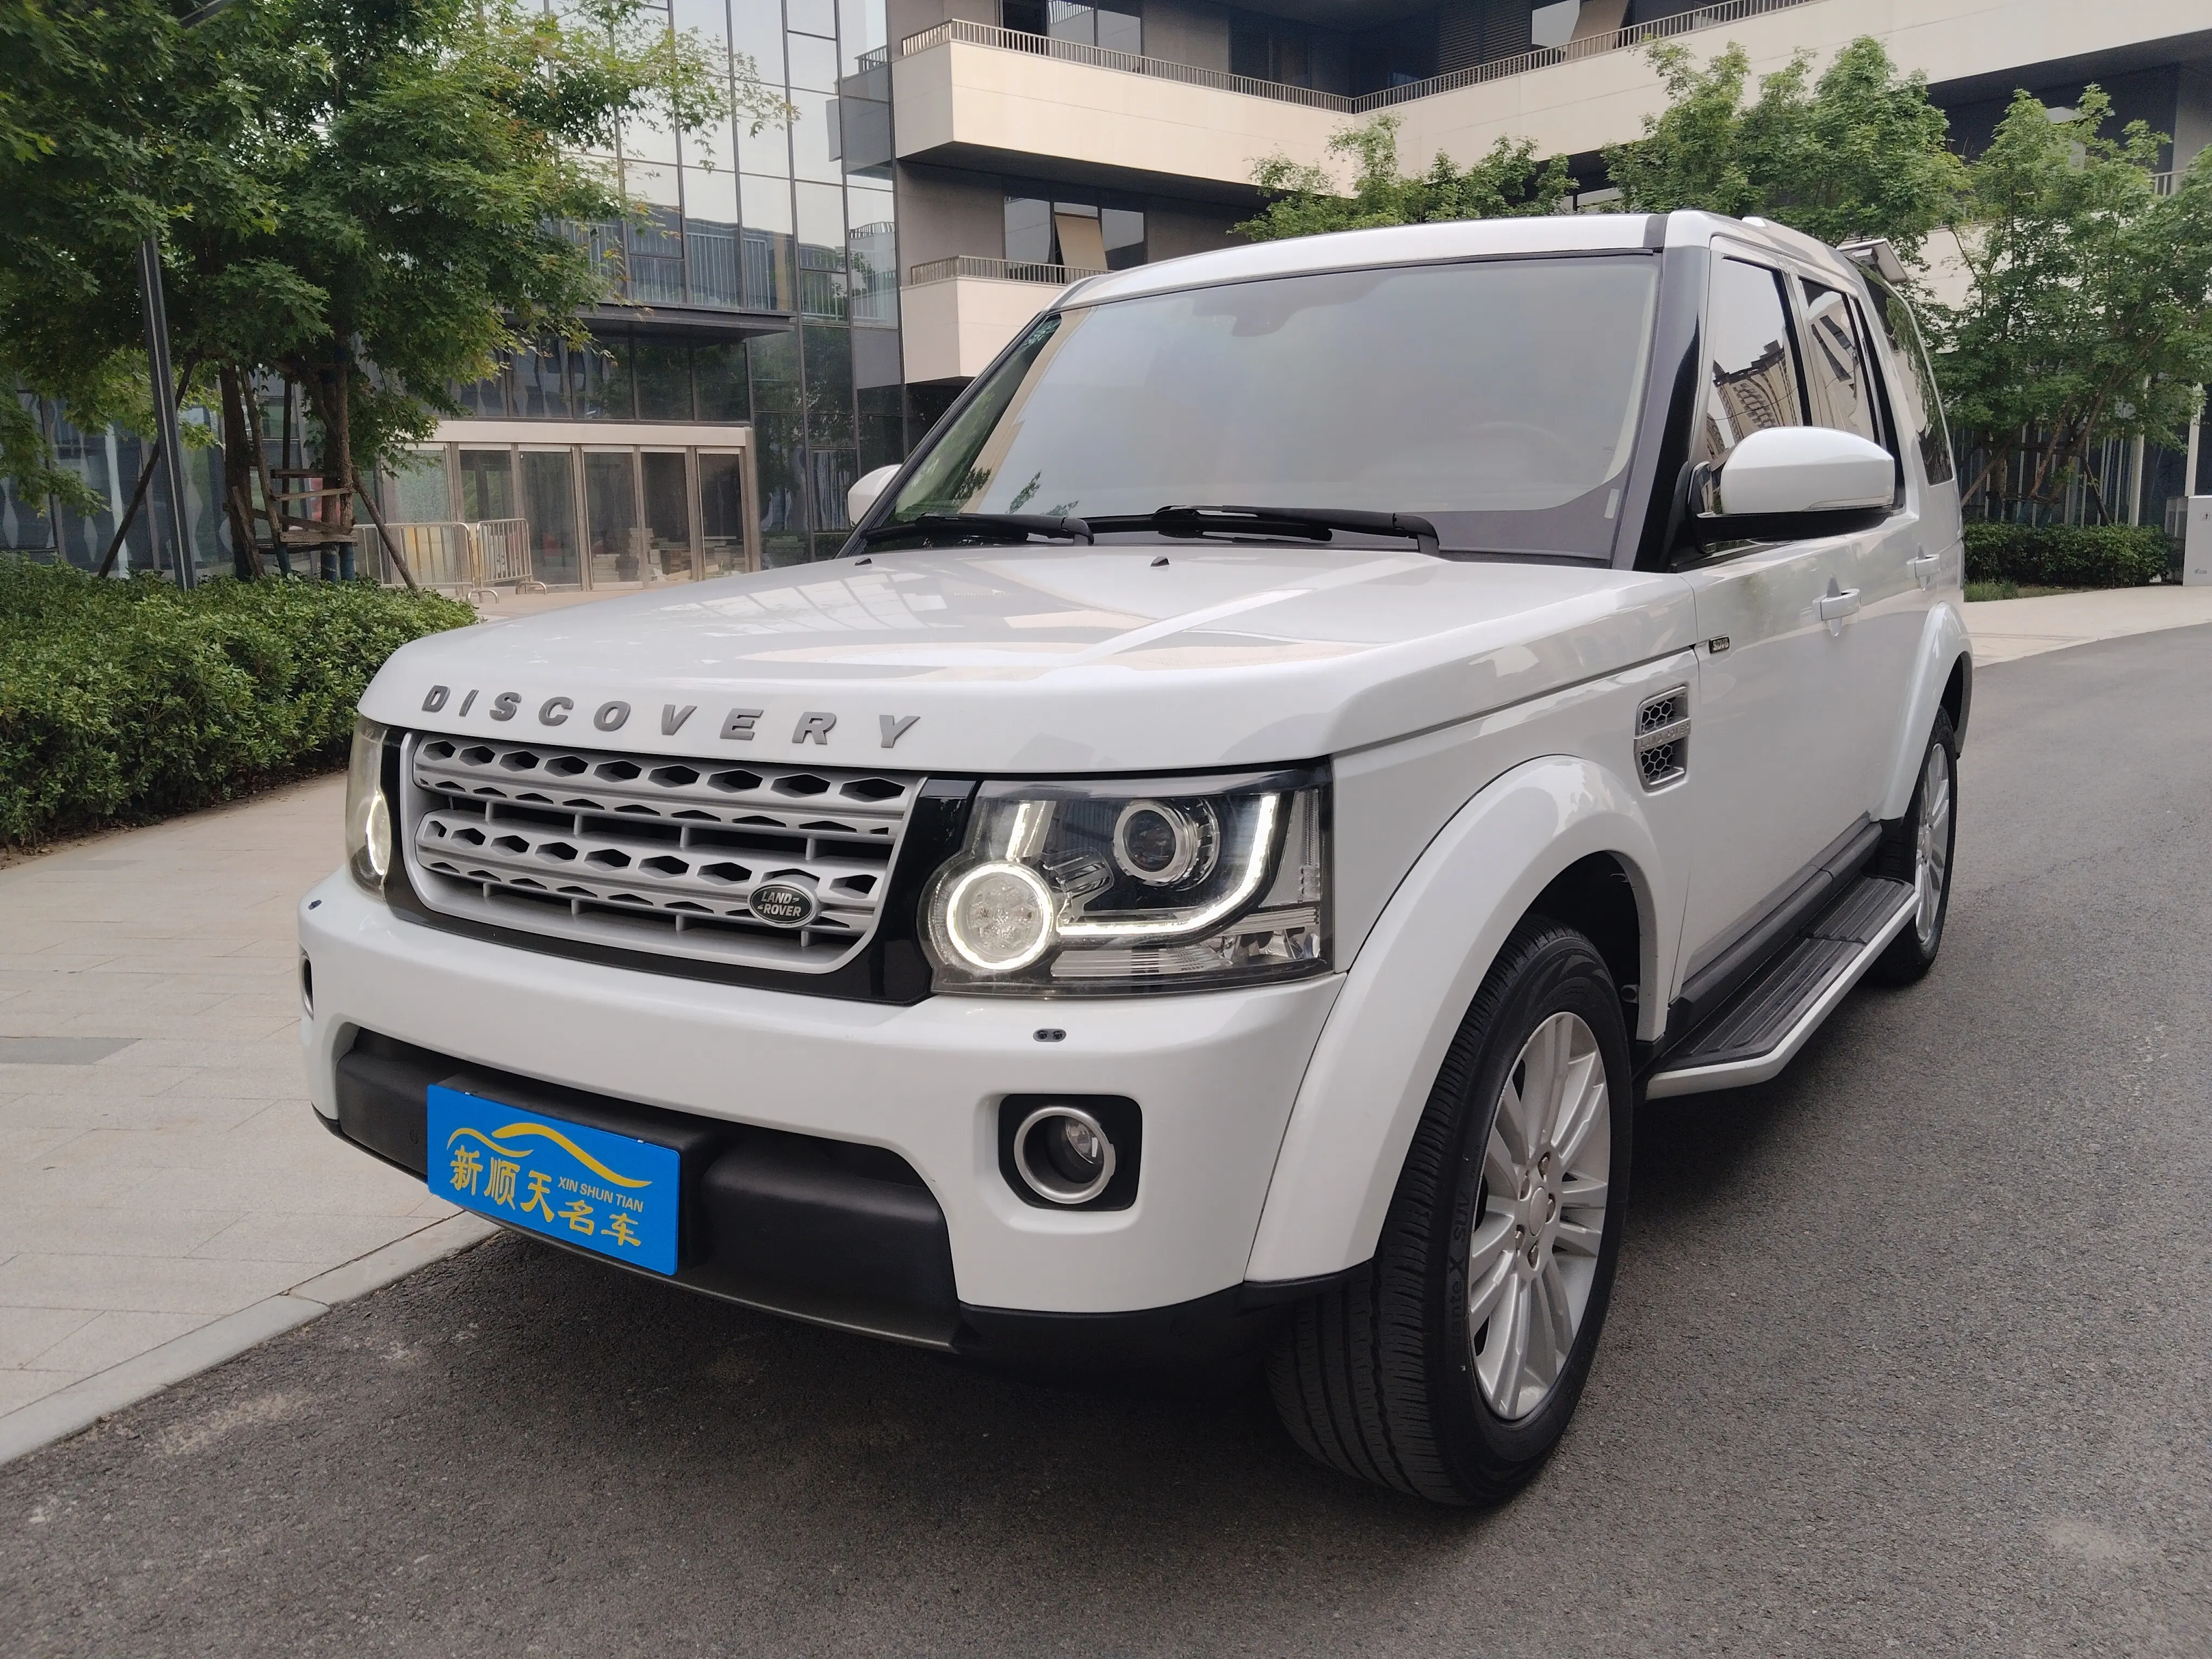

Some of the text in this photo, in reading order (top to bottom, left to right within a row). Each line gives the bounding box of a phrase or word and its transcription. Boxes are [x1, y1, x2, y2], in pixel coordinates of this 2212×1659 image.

[422, 684, 920, 748] DISCOVERY
[761, 891, 792, 904] LAND
[763, 903, 801, 917] ROVER
[450, 1144, 641, 1246] 新顺天名车
[558, 1176, 644, 1212] XIN SHUN TIAN
